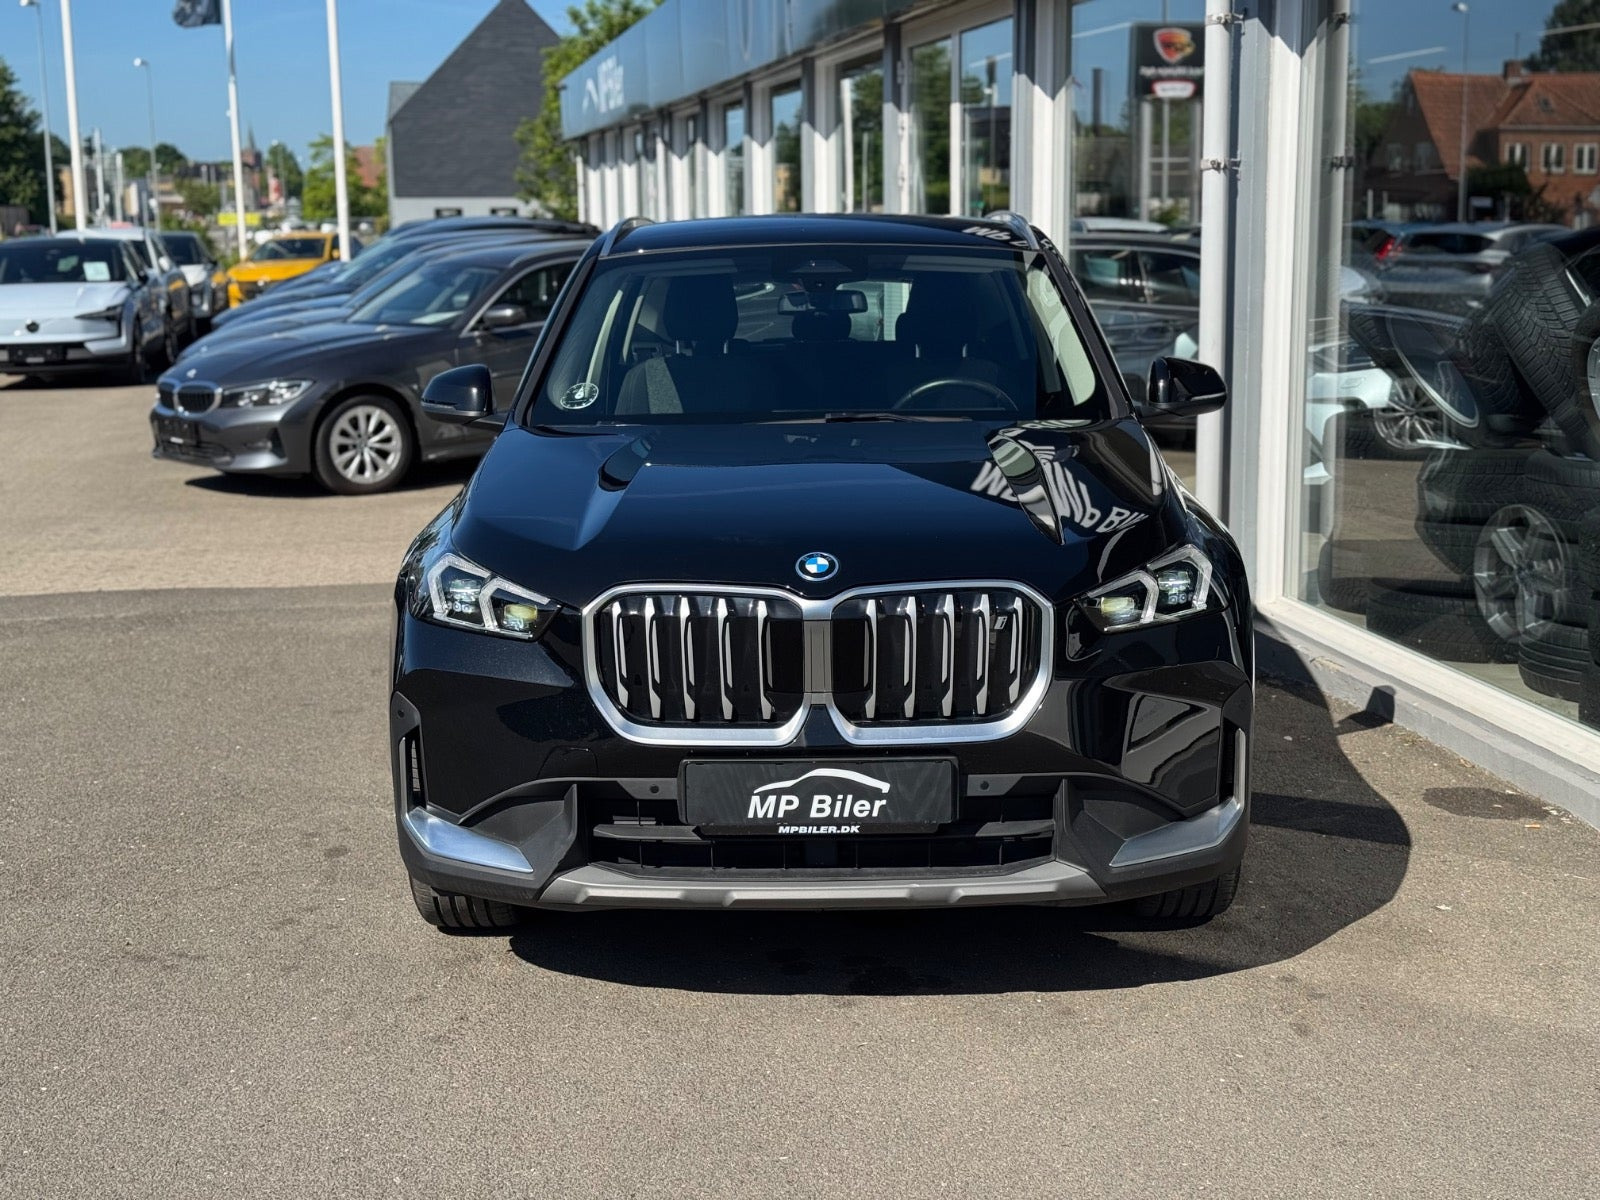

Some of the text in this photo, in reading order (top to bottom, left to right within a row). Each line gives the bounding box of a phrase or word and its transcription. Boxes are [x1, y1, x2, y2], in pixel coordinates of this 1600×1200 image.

[747, 794, 887, 819] MP Biler
[778, 825, 861, 834] MPBILER.DK
